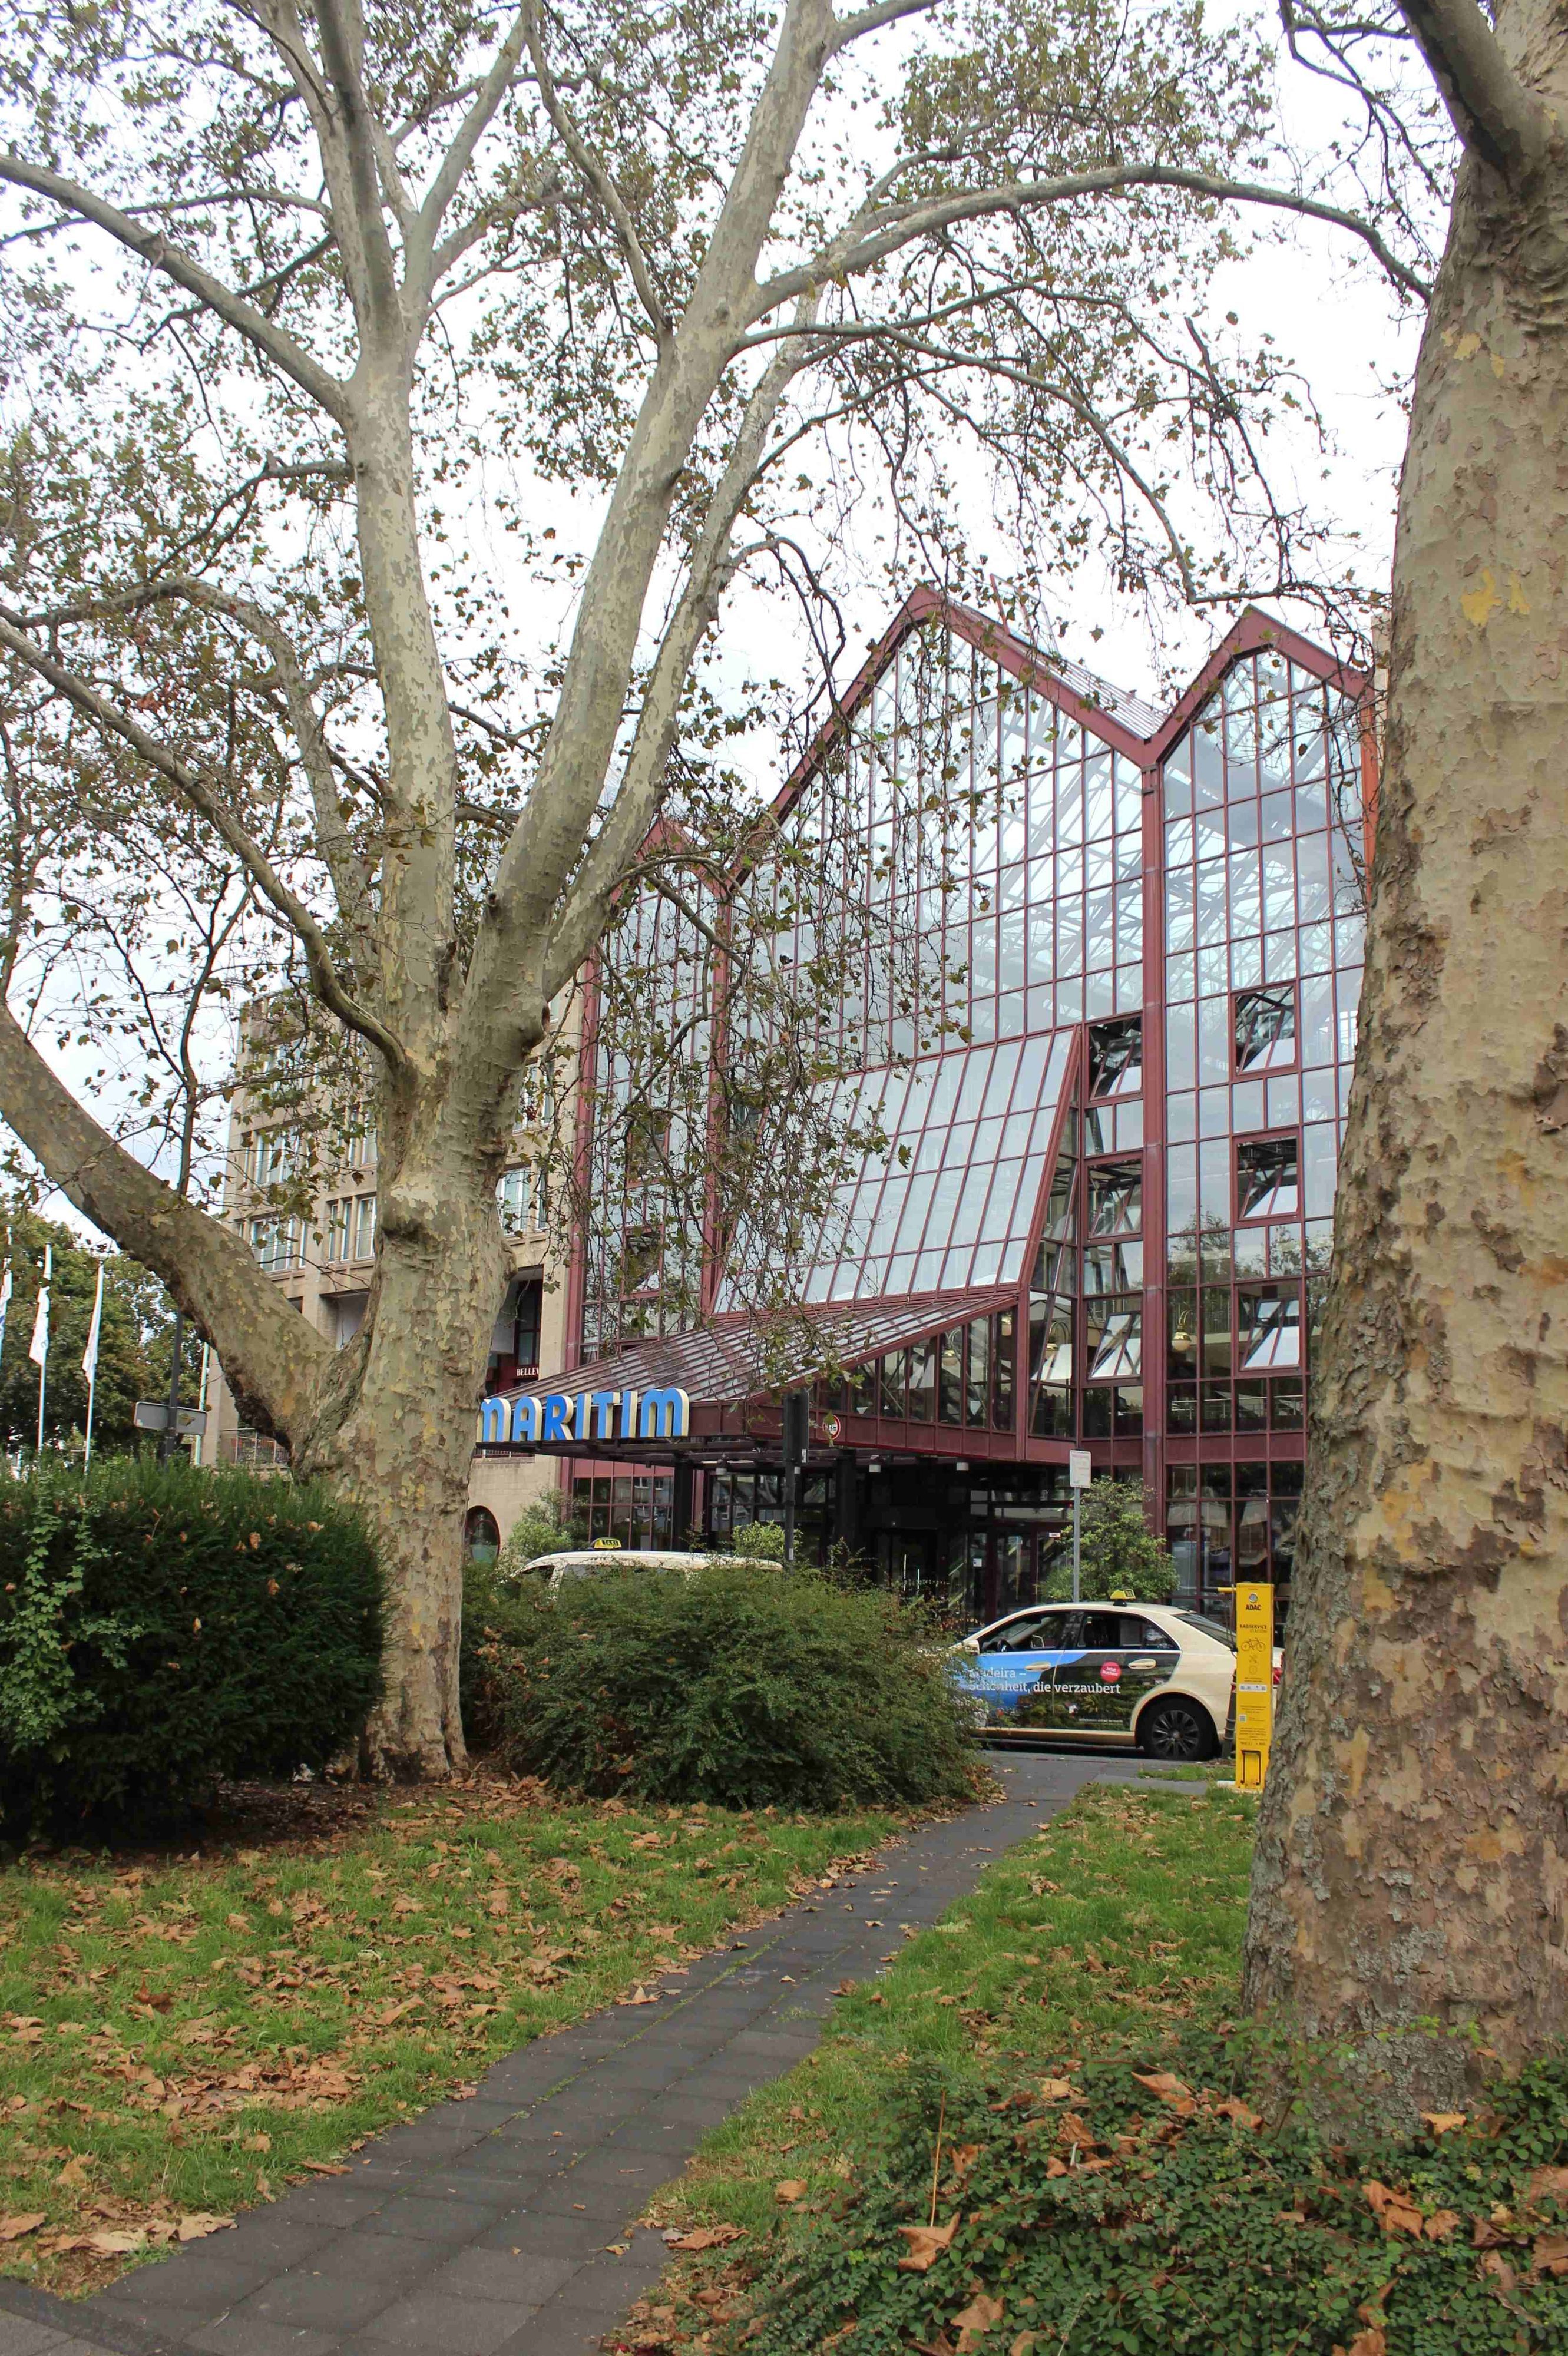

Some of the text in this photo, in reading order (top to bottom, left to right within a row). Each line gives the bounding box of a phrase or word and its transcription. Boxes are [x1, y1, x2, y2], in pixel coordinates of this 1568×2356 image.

[477, 1387, 689, 1442] MARITIM
[1033, 1682, 1051, 1693] die
[1053, 1682, 1121, 1694] verzaubert
